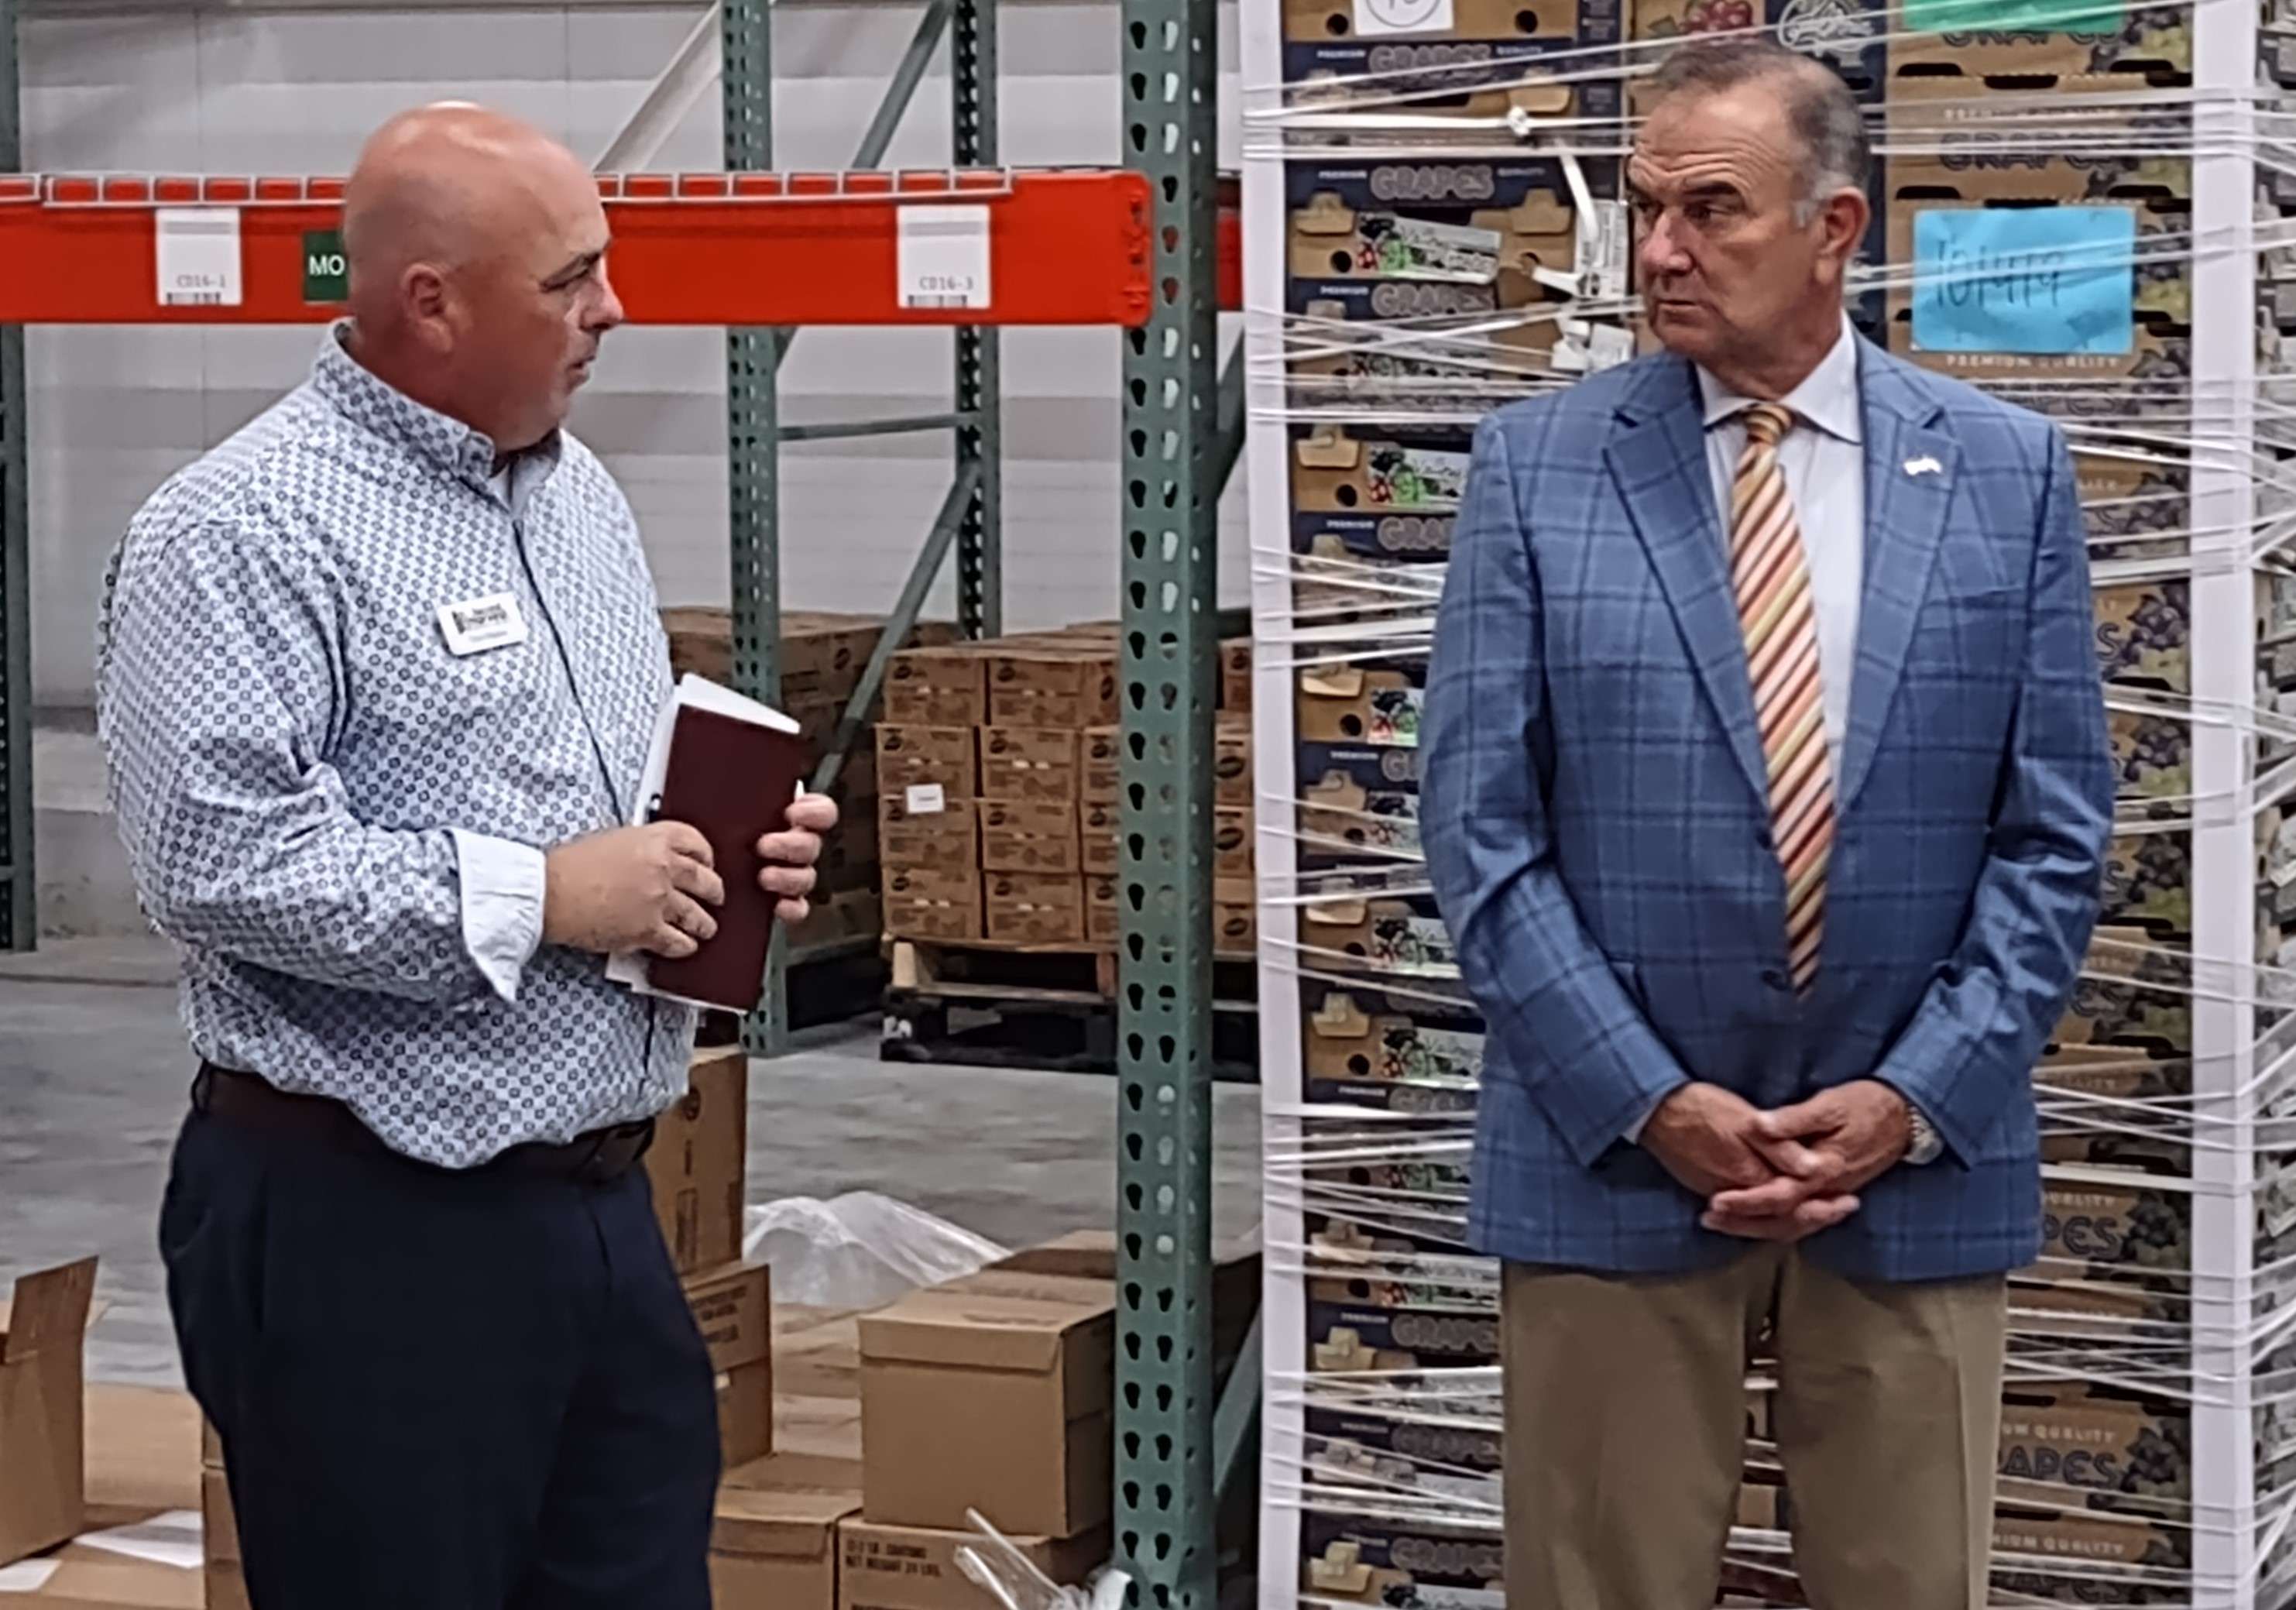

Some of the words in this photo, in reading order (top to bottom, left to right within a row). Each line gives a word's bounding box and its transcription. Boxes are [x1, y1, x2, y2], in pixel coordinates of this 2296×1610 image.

[1371, 165, 1495, 201] GRAPES
[308, 255, 345, 276] MO
[1946, 354, 2032, 368] PREMIUM
